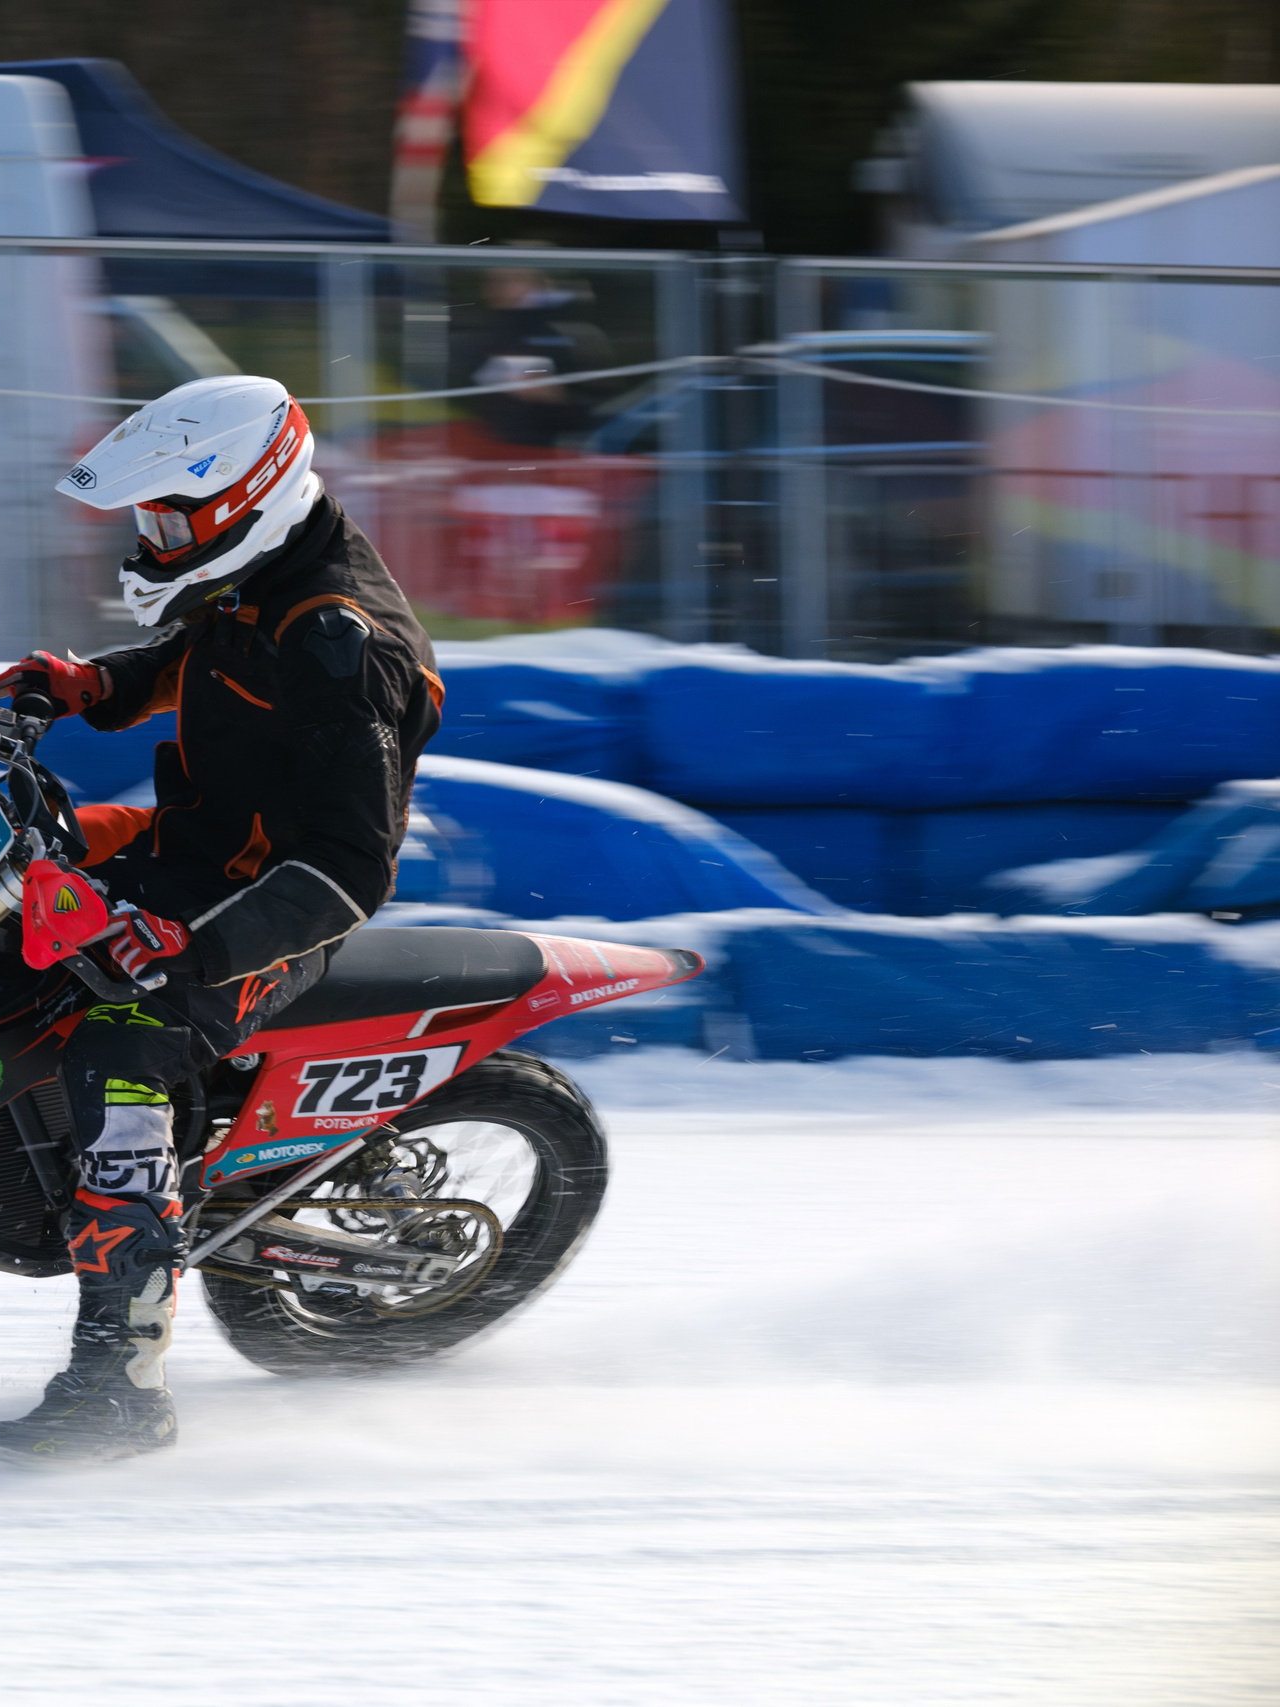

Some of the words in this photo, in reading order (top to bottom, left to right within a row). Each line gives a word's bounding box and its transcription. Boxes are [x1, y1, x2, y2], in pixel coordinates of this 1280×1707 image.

[214, 426, 301, 525] LS2
[569, 978, 640, 1005] DUNLOP
[298, 1054, 428, 1113] 723
[314, 1115, 379, 1130] POTEMKIN
[258, 1142, 327, 1161] MOTOREX
